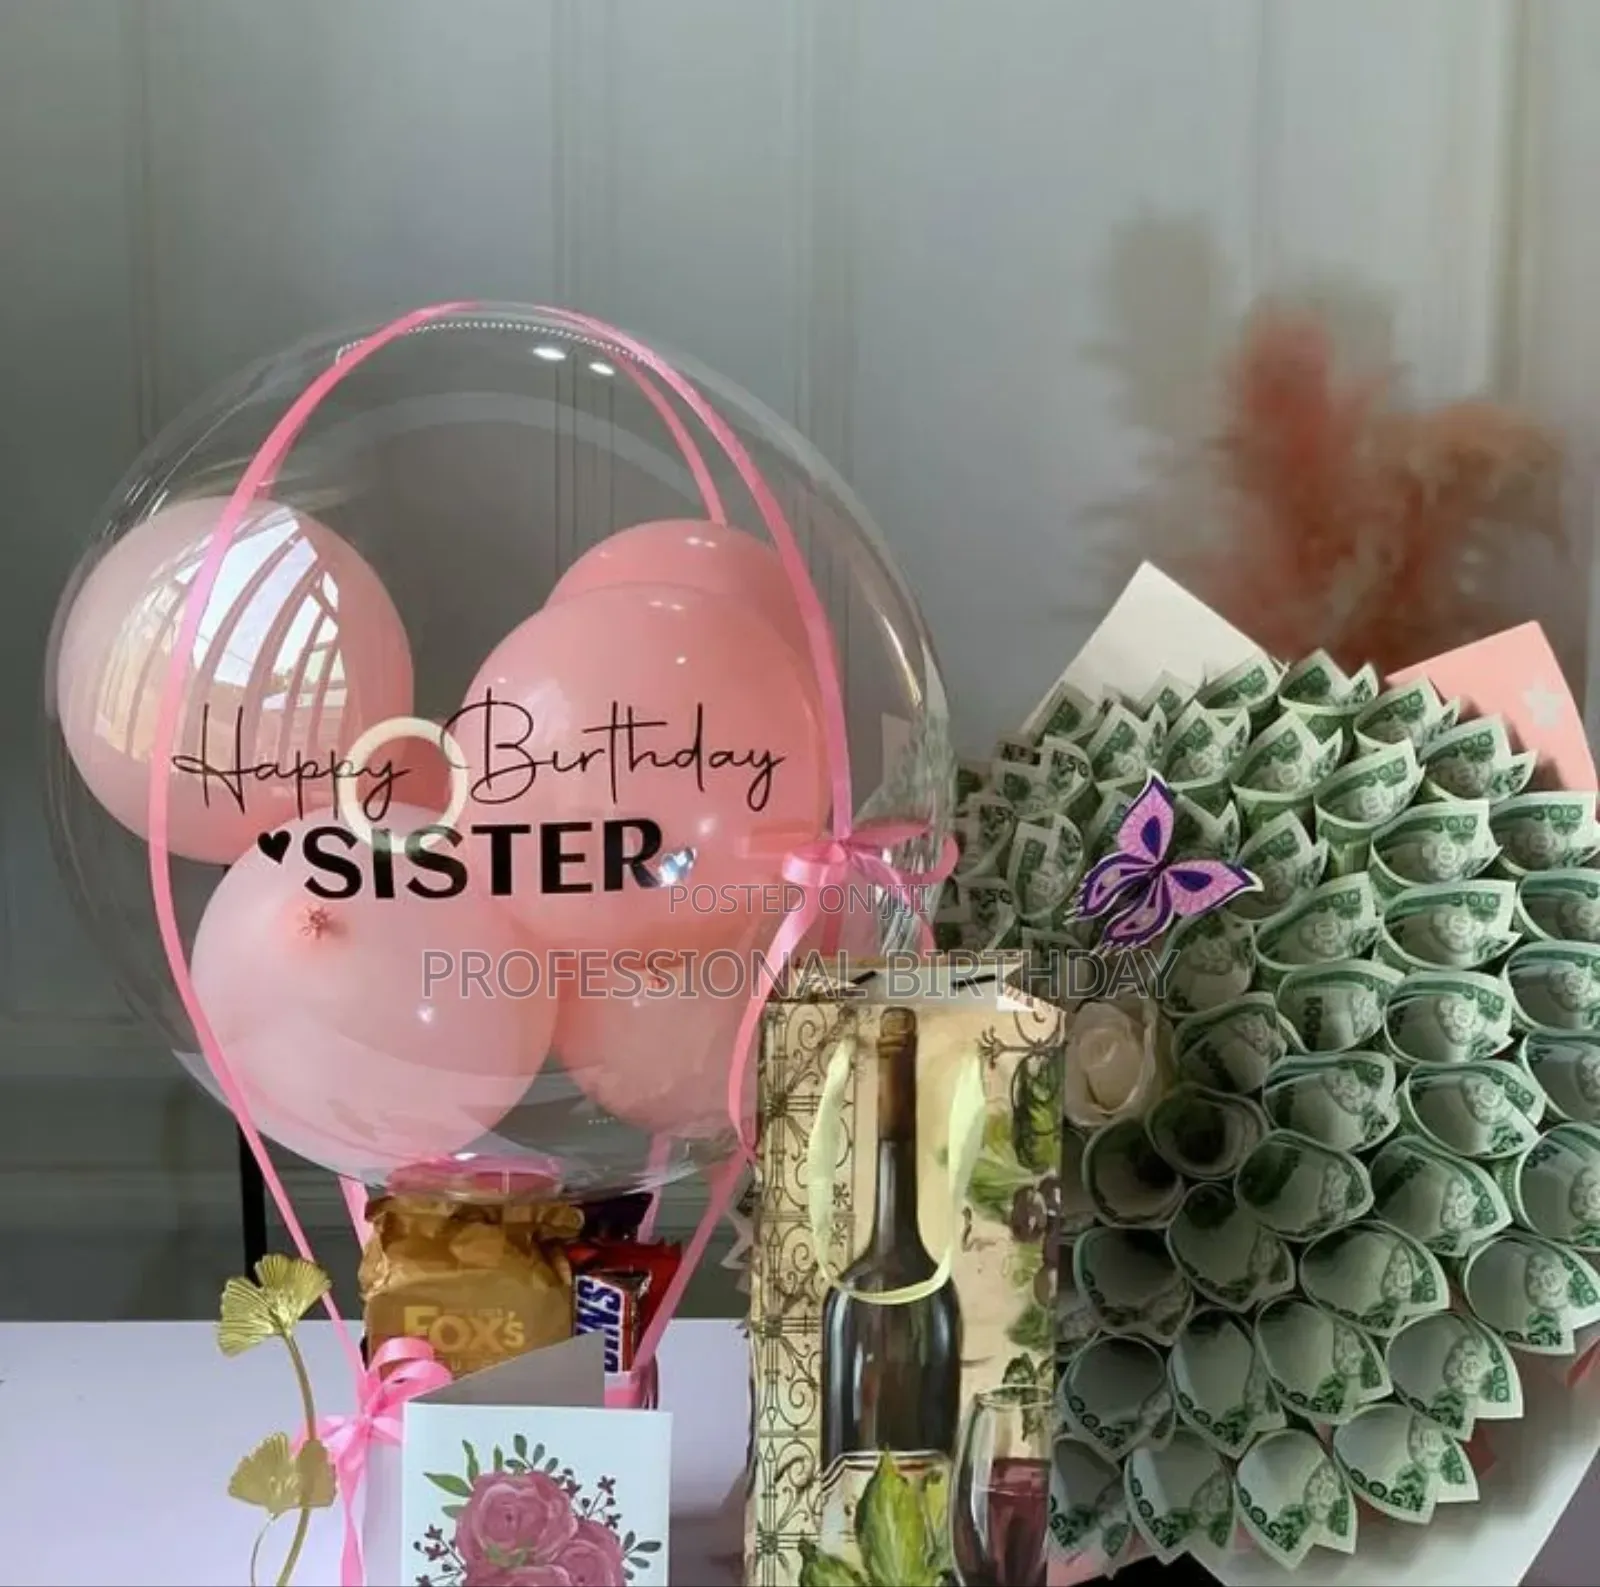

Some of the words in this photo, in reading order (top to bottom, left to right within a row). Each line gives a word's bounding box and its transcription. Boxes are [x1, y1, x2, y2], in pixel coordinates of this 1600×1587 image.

[172, 702, 411, 820] Happy
[439, 686, 786, 812] Birthday
[302, 818, 660, 898] SISTER
